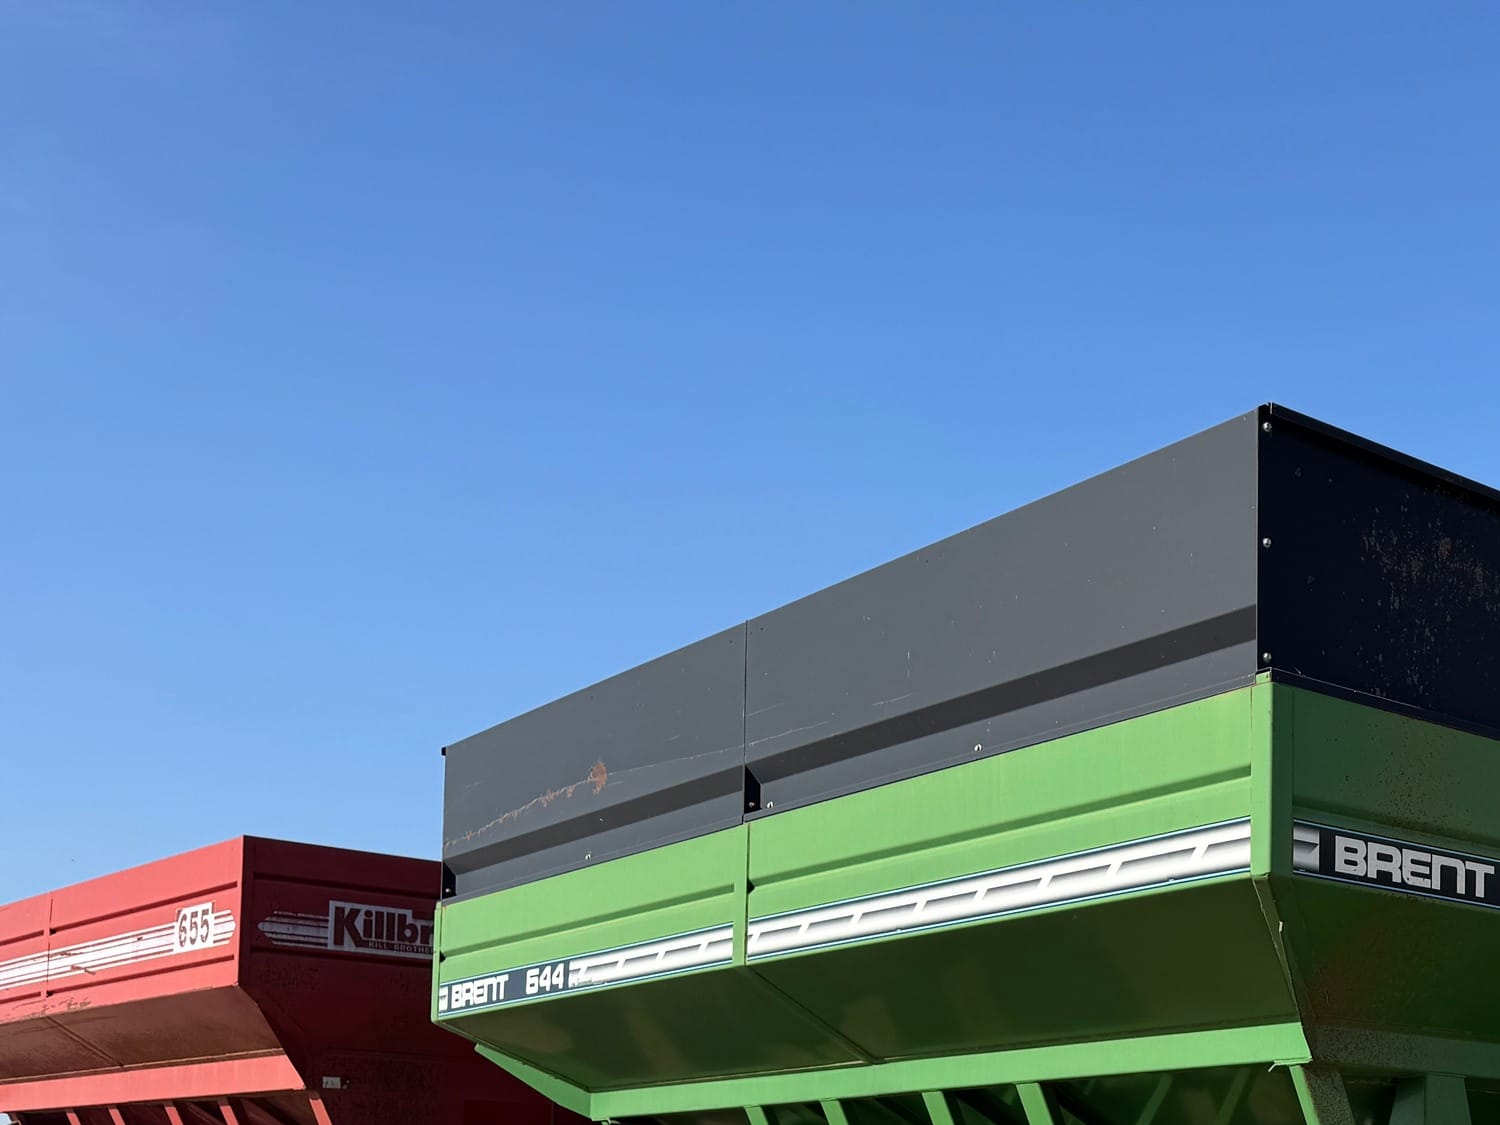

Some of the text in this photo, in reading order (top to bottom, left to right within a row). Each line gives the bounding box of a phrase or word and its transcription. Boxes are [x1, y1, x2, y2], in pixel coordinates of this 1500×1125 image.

[1334, 835, 1495, 898] BRENT
[178, 908, 210, 948] 655
[368, 940, 433, 954] KILL BROTHE
[451, 963, 565, 1009] BRENT 644
